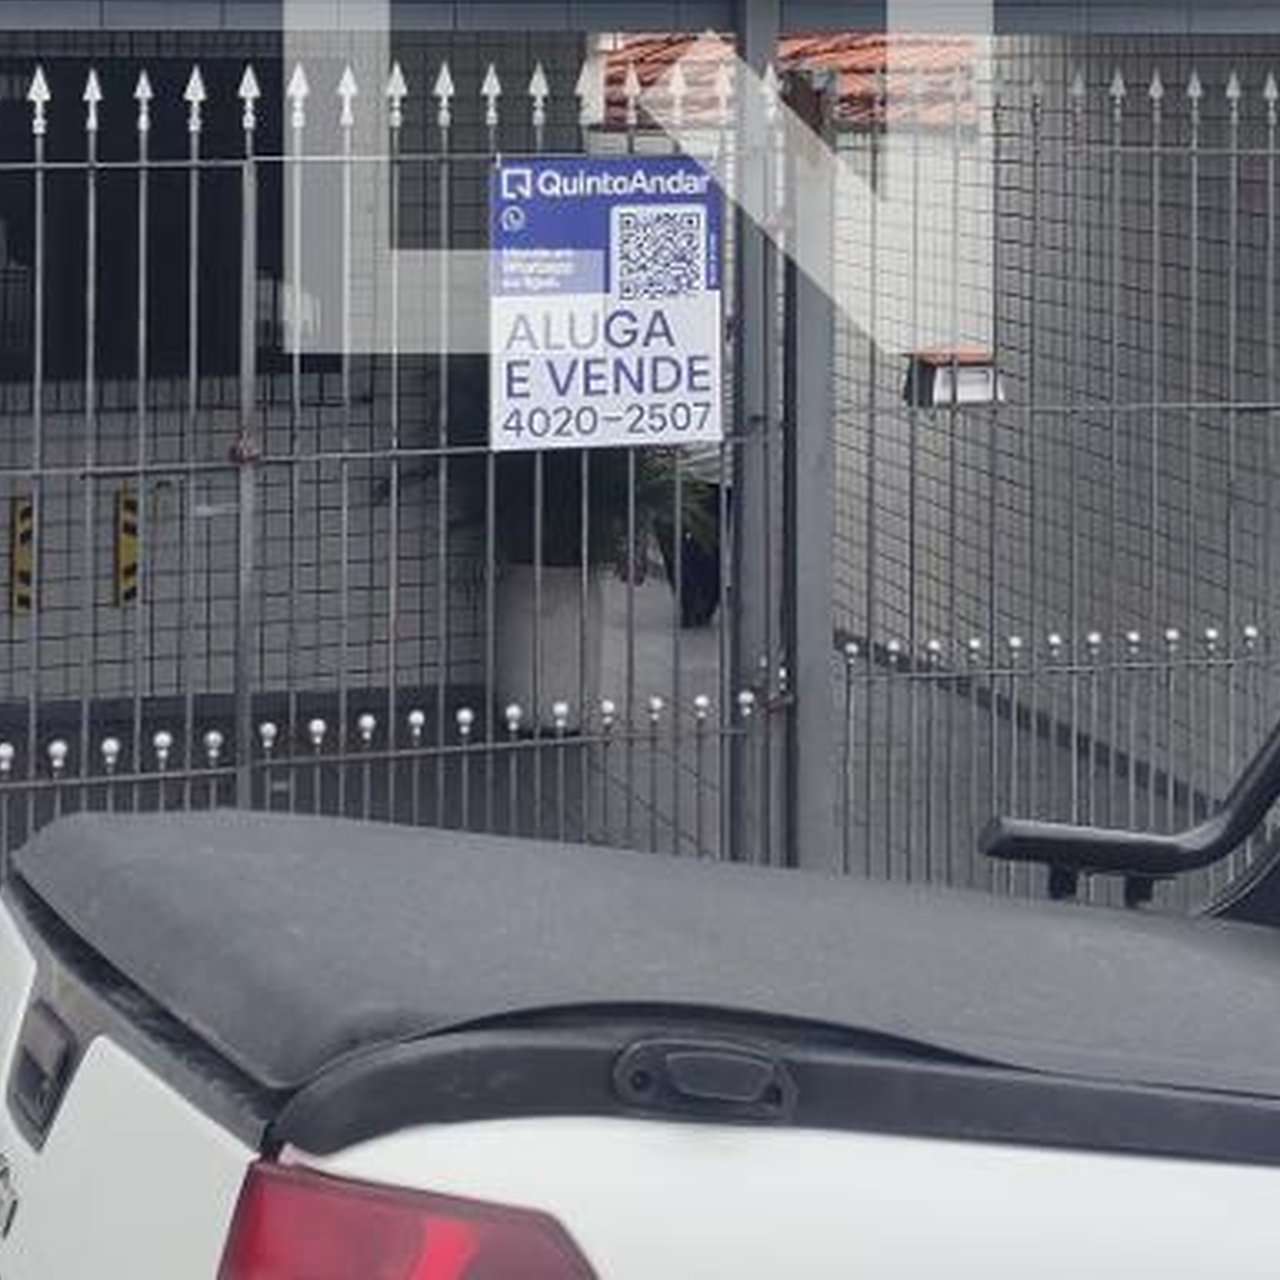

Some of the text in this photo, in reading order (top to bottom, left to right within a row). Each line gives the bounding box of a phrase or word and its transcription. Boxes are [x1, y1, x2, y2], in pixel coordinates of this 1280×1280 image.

[537, 170, 711, 196] QuintoAndar
[505, 309, 675, 350] ALUGA
[505, 355, 711, 399] E VENDE
[502, 401, 712, 438] 4020-2507
